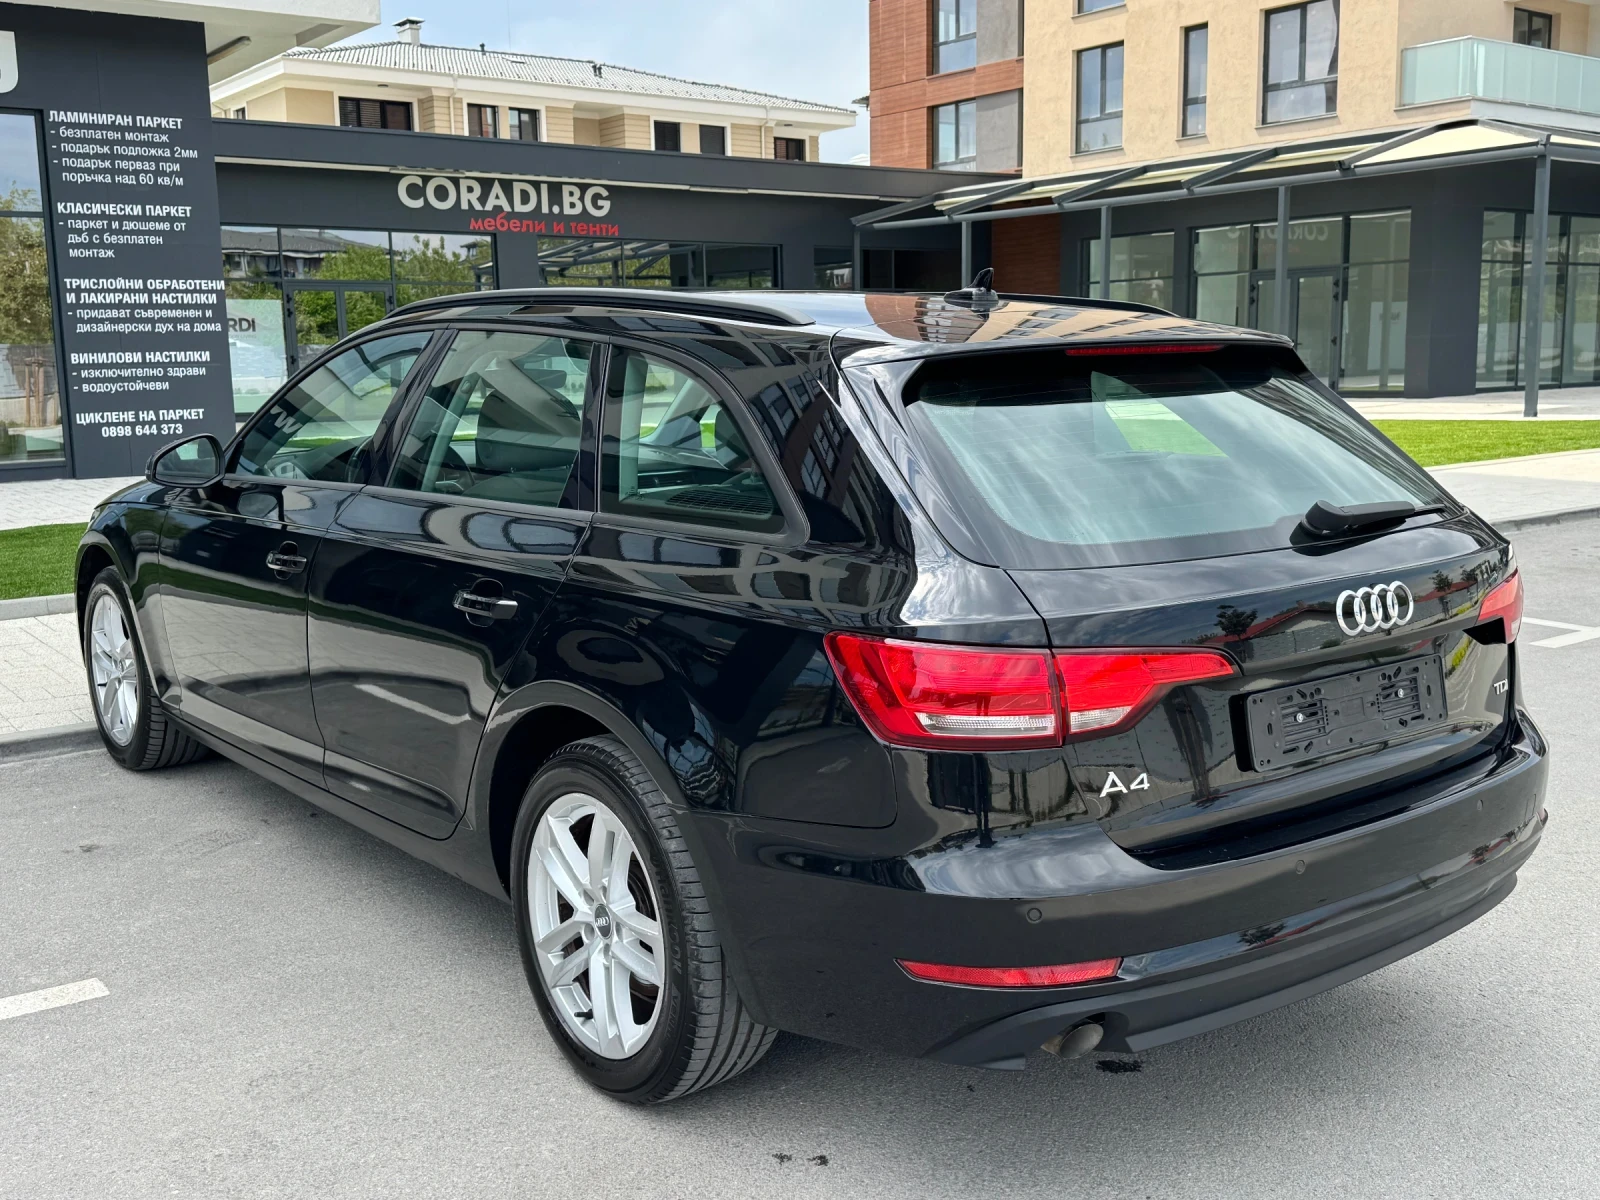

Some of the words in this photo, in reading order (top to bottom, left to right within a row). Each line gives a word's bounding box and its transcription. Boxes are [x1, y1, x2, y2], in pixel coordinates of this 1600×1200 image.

[49, 110, 132, 126] ЛАМИНИРАН
[136, 116, 182, 129] ПАРКЕТ
[59, 126, 121, 140] безплатен
[125, 132, 169, 142] монтаж
[61, 143, 110, 155] подарък
[114, 146, 171, 157] подложка
[174, 146, 198, 158] 2мм
[62, 158, 112, 170] подарък
[115, 160, 156, 172] перваз
[159, 162, 180, 173] при
[62, 172, 112, 184] поръчка
[115, 175, 136, 185] над
[139, 173, 154, 184] 60
[158, 174, 183, 186] кв/м
[397, 175, 611, 217] CORADI.BG
[57, 202, 142, 215] КЛАСИЧЕСКИ
[146, 205, 192, 217] ПАРКЕТ
[68, 220, 108, 231] паркет
[112, 221, 119, 229] и
[122, 221, 170, 231] дюшеме
[174, 222, 186, 231] от
[470, 212, 545, 233] мебели
[553, 222, 564, 234] и
[570, 222, 619, 236] тенти
[67, 232, 89, 244] дъб
[93, 234, 100, 243] с
[103, 232, 163, 244] безплатен
[69, 249, 115, 258] монтаж
[64, 277, 143, 289] ТРИСЛОЙНИ
[147, 279, 225, 290] ОБРАБОТЕНИ
[66, 293, 76, 303] И
[80, 293, 148, 304] ЛАКИРАНИ
[152, 293, 217, 304] НАСТИЛКИ
[76, 309, 131, 320] придават
[134, 309, 202, 320] съвременен
[205, 309, 212, 318] и
[76, 321, 152, 334] дизайнерски
[155, 323, 174, 334] дух
[177, 323, 191, 331] на
[193, 323, 222, 332] дома
[71, 352, 142, 364] ВИНИЛОВИ
[146, 351, 210, 362] НАСТИЛКИ
[81, 368, 164, 378] изключително
[167, 367, 206, 378] здрави
[82, 380, 169, 393] водоустойчеви
[76, 411, 136, 426] ЦИКЛЕНЕ
[139, 410, 156, 421] НА
[159, 409, 204, 420] ПАРКЕТ
[102, 426, 132, 437] 0898
[135, 424, 158, 436] 644
[161, 423, 183, 435] 373
[1099, 771, 1150, 798] A4
